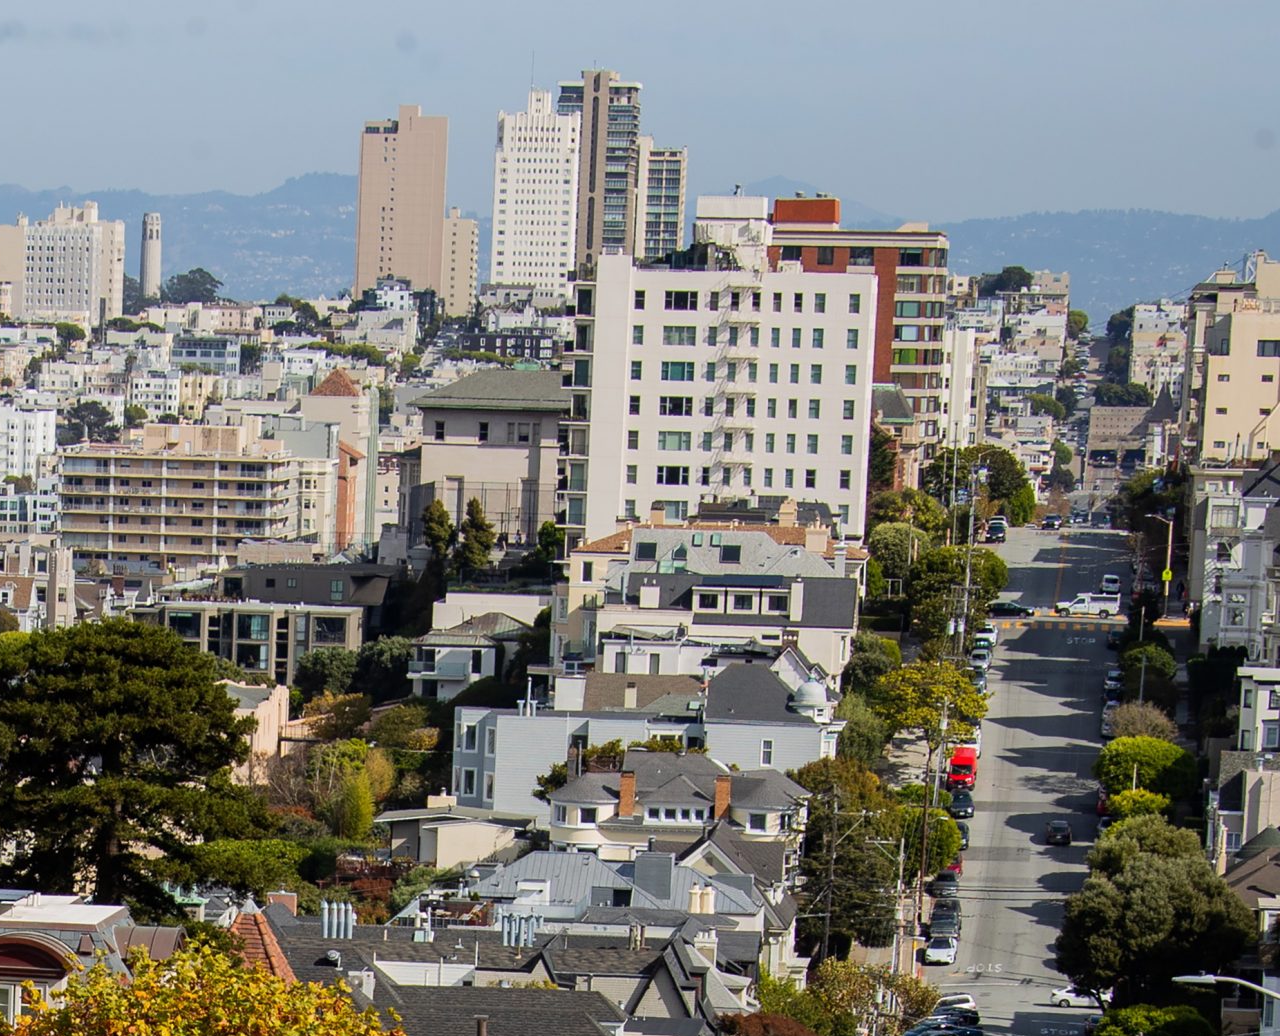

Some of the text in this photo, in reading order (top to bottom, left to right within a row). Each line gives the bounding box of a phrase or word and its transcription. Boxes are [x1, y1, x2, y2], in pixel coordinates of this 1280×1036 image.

[1066, 636, 1096, 645] STOP
[966, 962, 1003, 973] STOP
[1040, 1028, 1079, 1036] STOP
